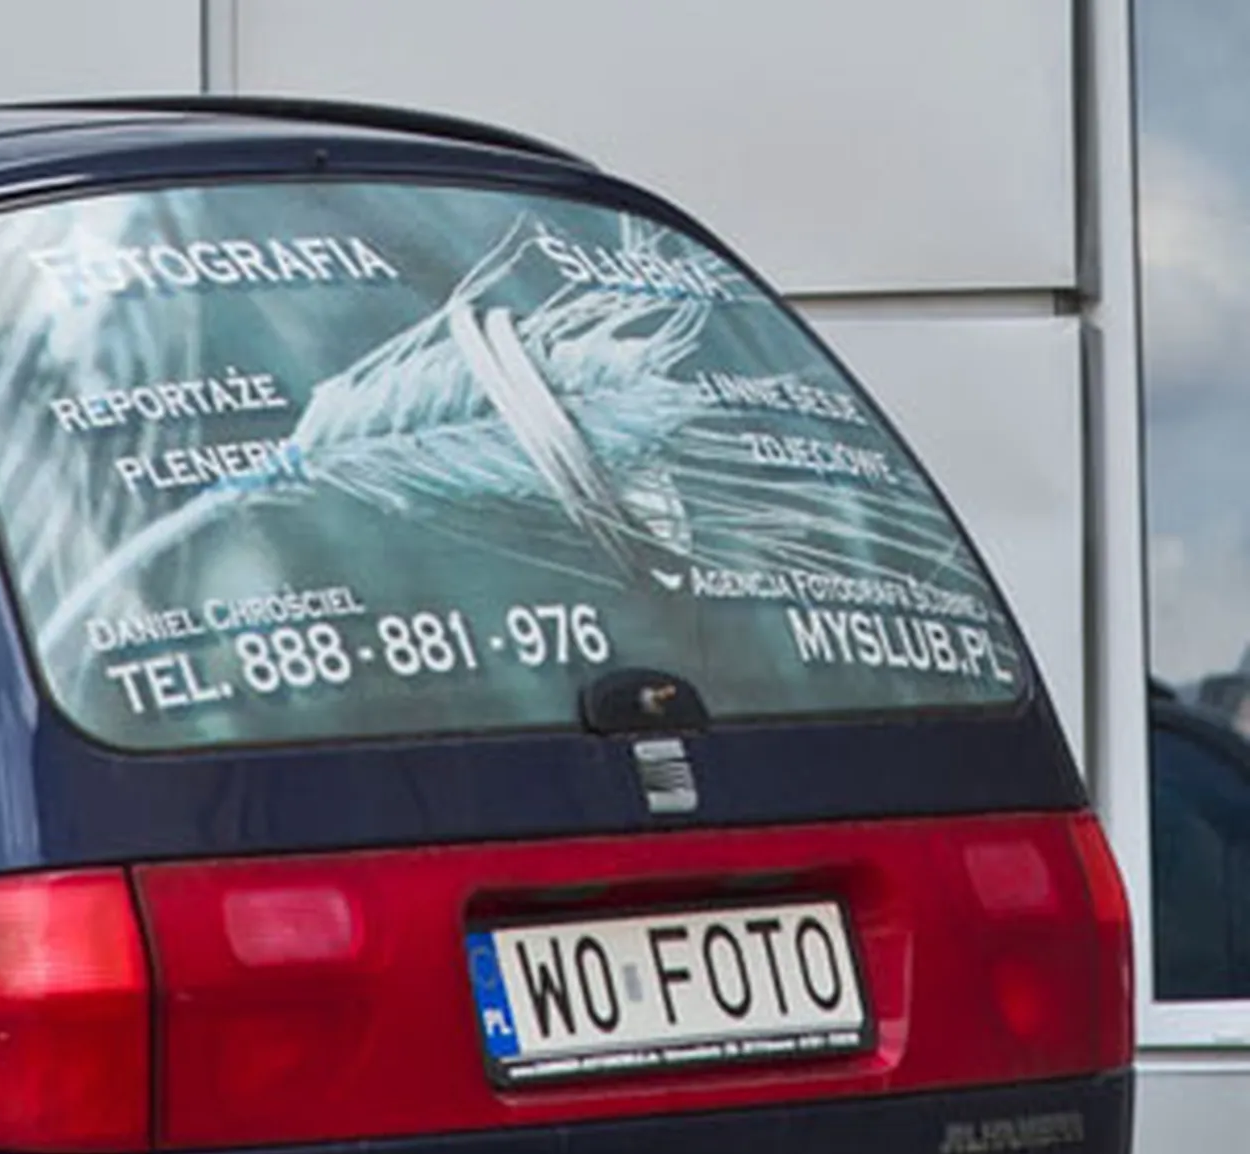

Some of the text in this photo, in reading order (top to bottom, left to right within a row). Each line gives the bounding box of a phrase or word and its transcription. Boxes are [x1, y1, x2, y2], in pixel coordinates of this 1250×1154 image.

[32, 236, 398, 295] FOTOGRAFIA
[52, 366, 288, 431] REPORTAŻE
[115, 440, 302, 492] PLENERY
[85, 608, 203, 651] DANIEL
[787, 607, 1013, 683] MYSLUB.PL
[107, 655, 233, 713] TEL.
[648, 916, 843, 1025] FOTO
